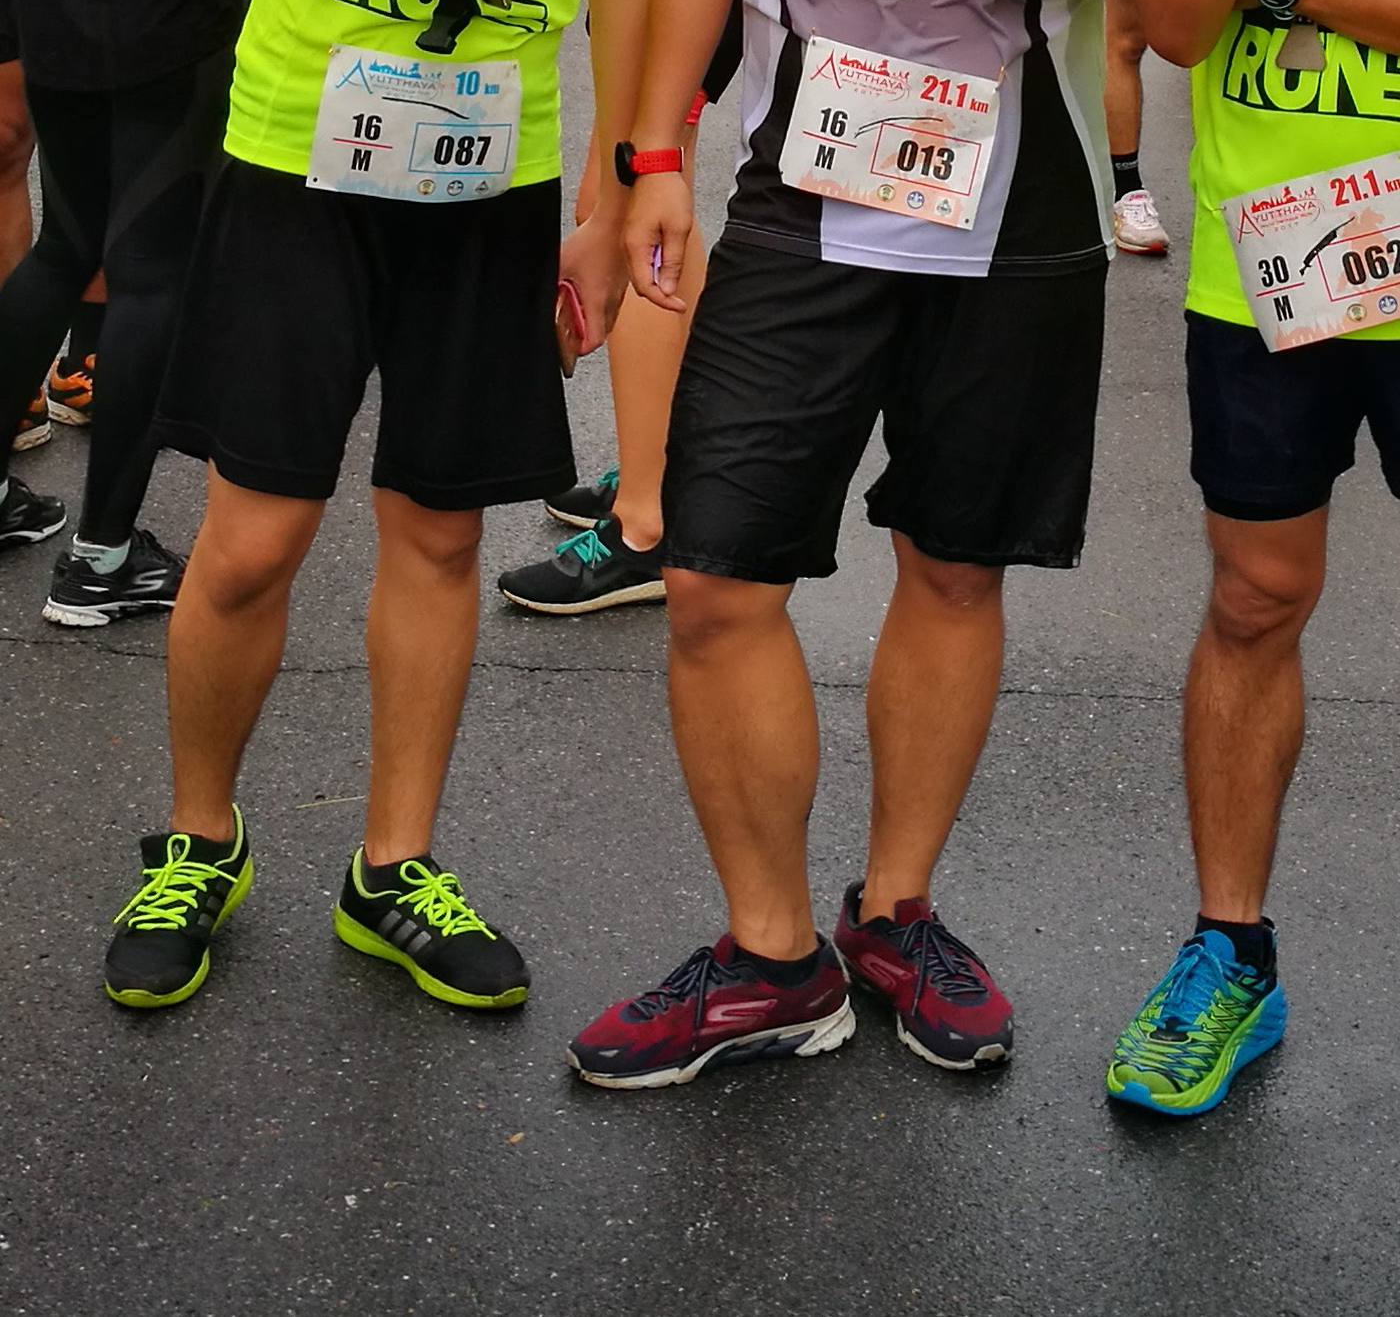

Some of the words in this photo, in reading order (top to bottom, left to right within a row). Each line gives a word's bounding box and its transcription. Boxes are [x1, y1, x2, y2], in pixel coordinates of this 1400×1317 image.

[336, 57, 436, 95] AYUTTHAYA
[456, 70, 480, 95] 10
[810, 49, 903, 90] AYUTTHAYA
[920, 75, 968, 108] 21.1
[969, 98, 989, 113] km
[353, 113, 382, 140] 16
[821, 107, 848, 137] 16
[351, 148, 372, 172] M
[433, 135, 491, 166] 087
[814, 144, 836, 170] M
[896, 139, 955, 180] 013
[1329, 169, 1381, 207] 21.1
[1237, 199, 1316, 243] AYUTTHAYA
[1258, 255, 1290, 288] 30
[1341, 239, 1400, 286] 062
[1273, 295, 1294, 322] M
